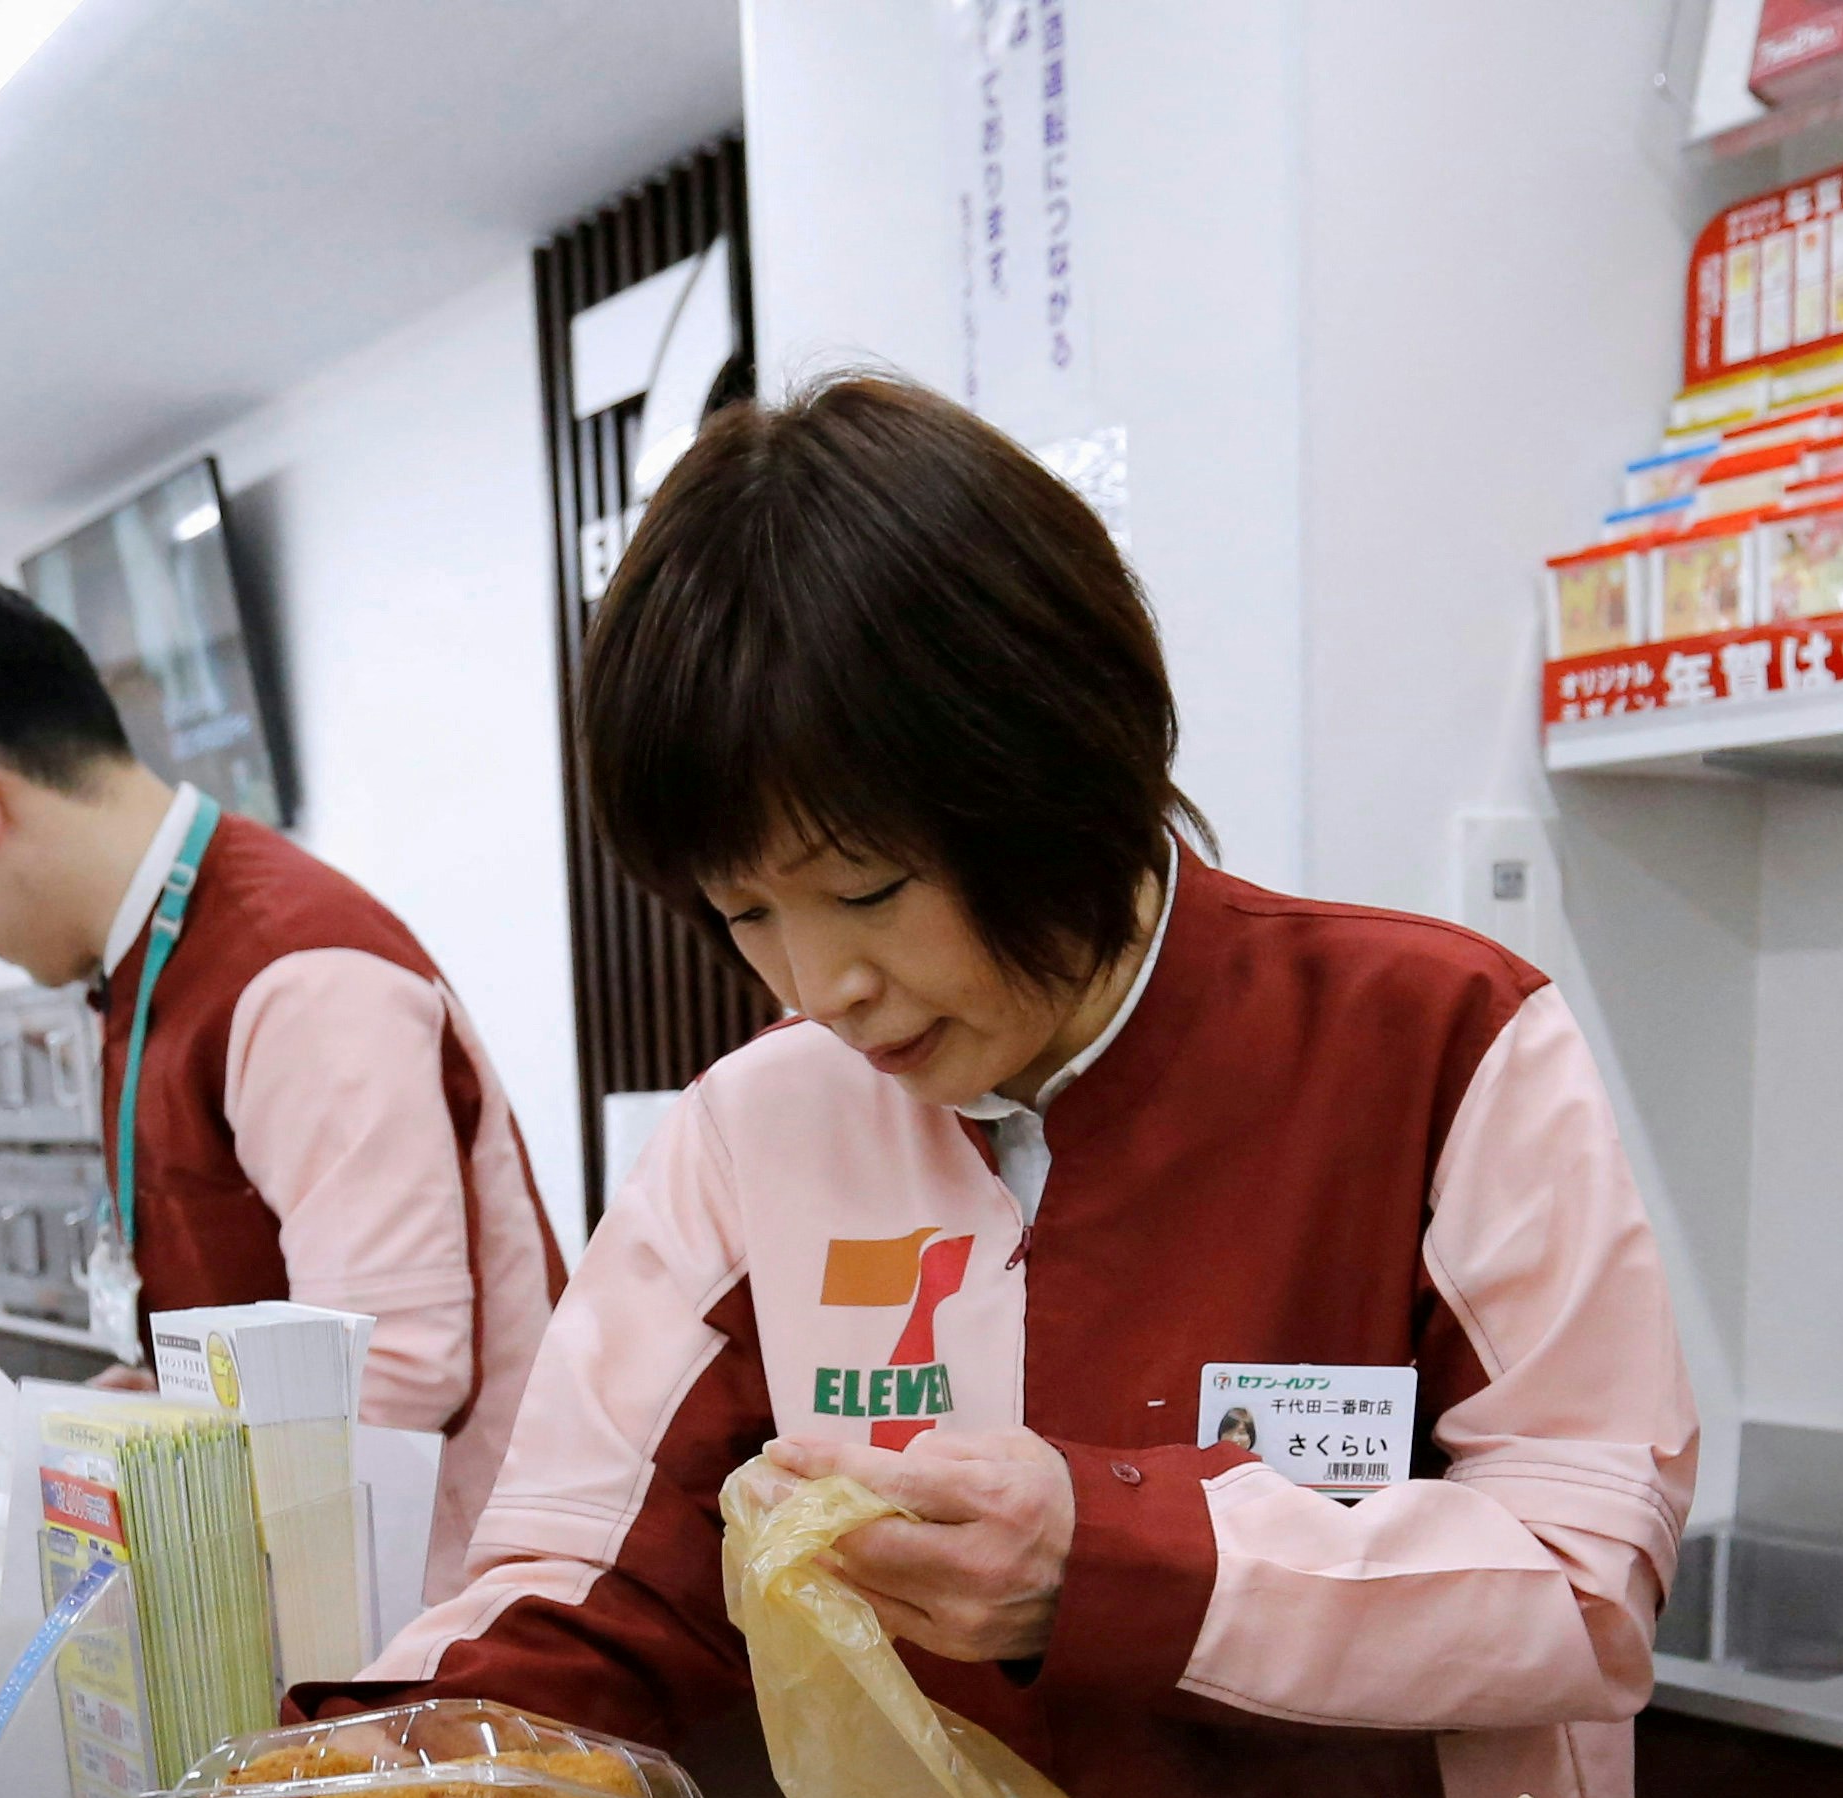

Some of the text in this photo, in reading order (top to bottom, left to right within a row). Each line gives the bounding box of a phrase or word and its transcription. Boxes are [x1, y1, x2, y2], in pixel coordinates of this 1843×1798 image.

[1270, 1399, 1394, 1416] 千代田二番町店
[1288, 1433, 1388, 1457] さくらい
